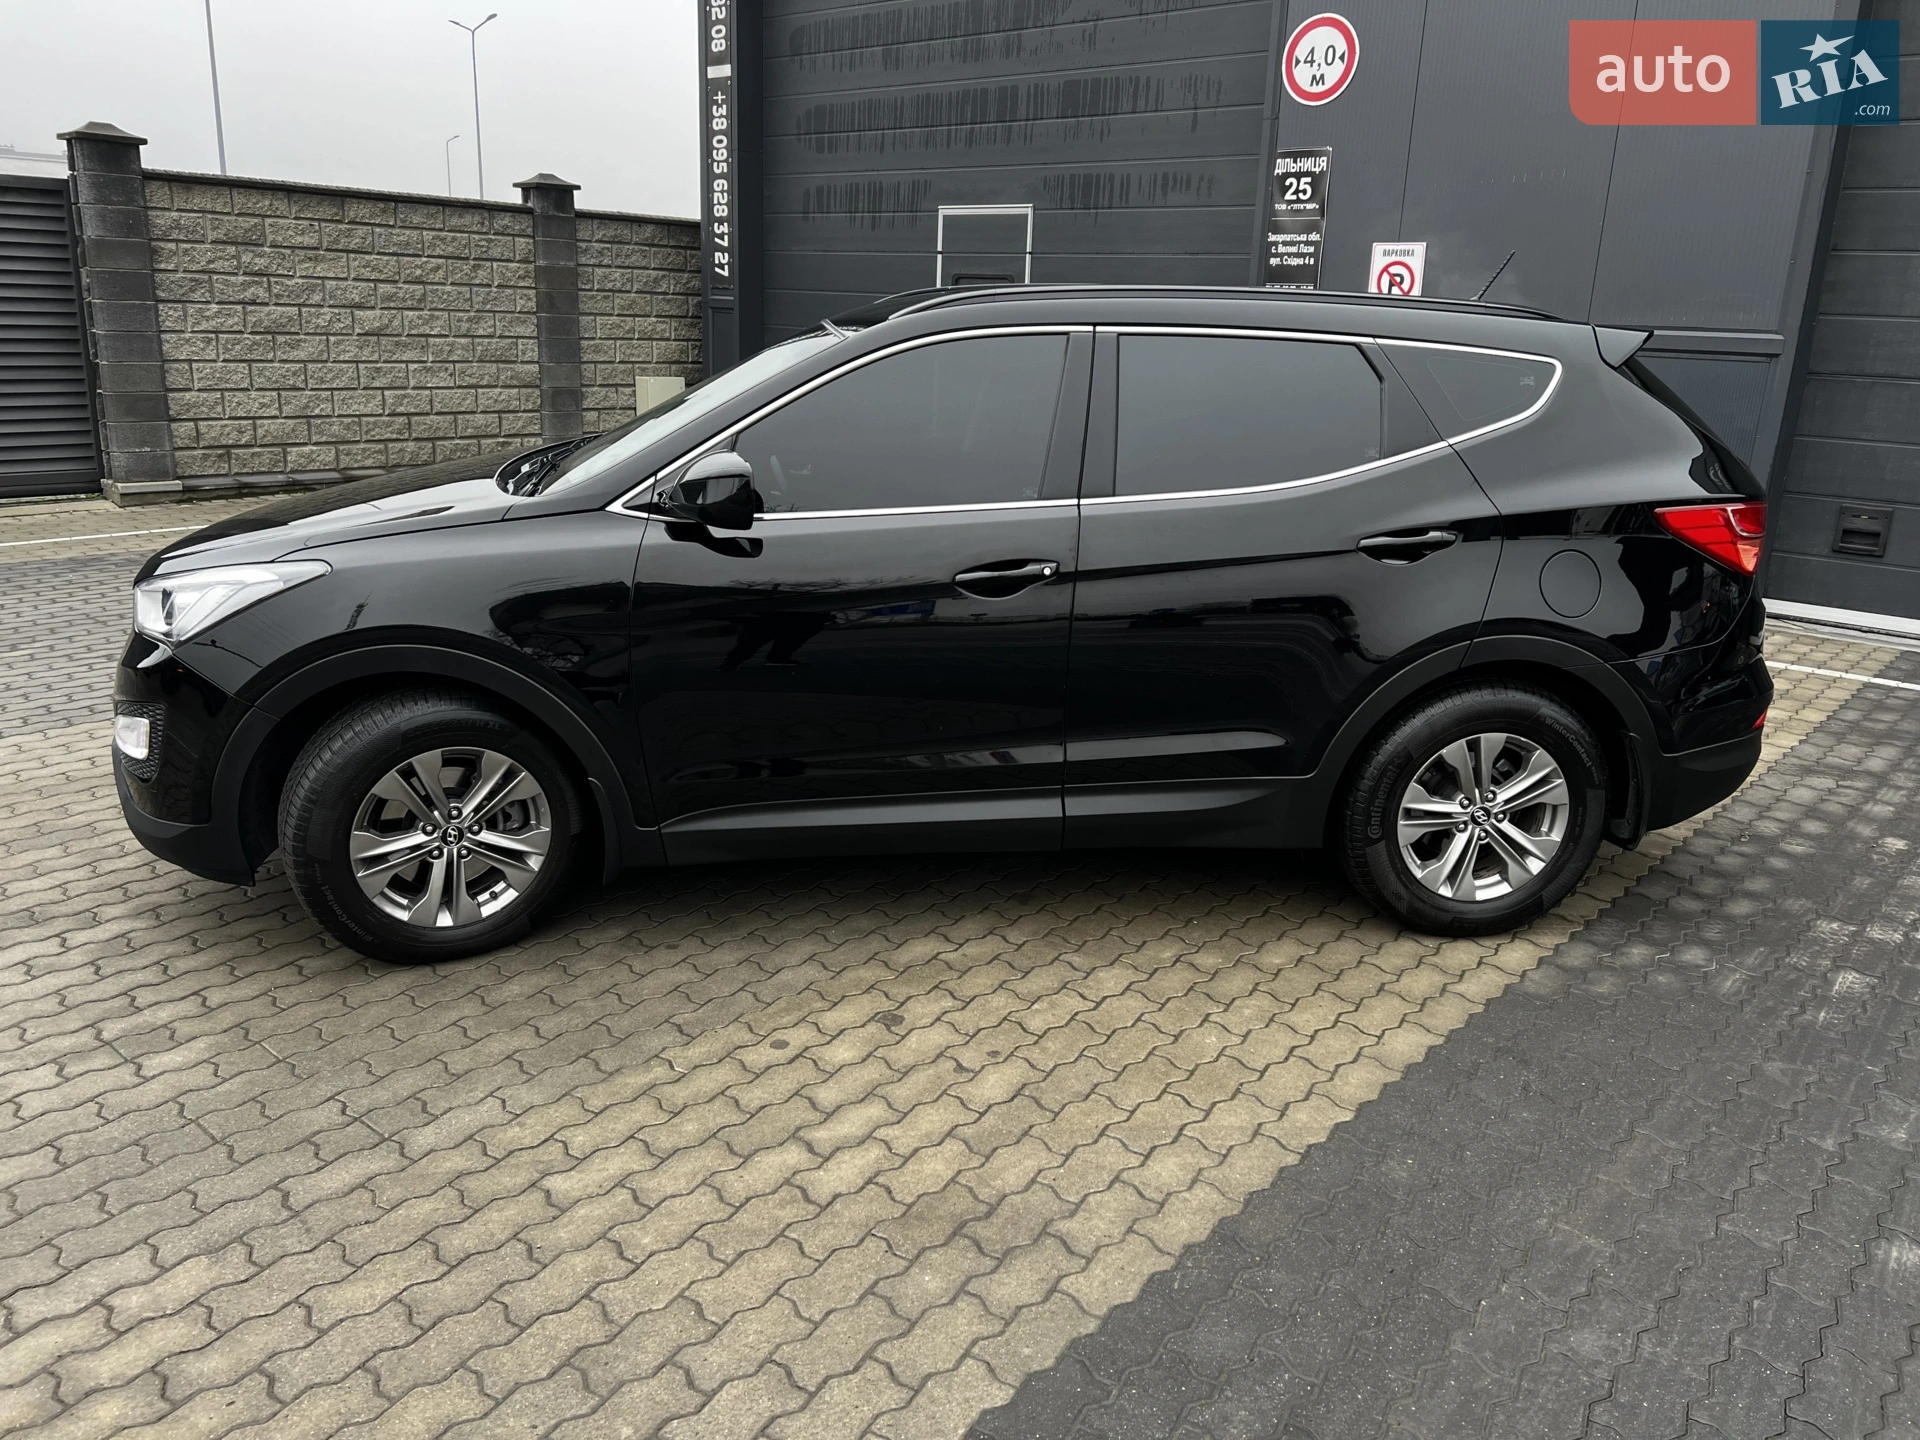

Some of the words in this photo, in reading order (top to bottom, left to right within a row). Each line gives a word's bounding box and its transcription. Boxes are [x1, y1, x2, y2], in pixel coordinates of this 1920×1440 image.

[711, 25, 727, 52] 08
[1303, 44, 1337, 71] 4,0
[712, 91, 728, 130] +38
[712, 135, 728, 174] 095
[1274, 156, 1328, 176] ДІЛЬНИЦЯ
[713, 179, 729, 217] 628
[1284, 177, 1312, 200] 25
[714, 222, 729, 247] 37
[1267, 232, 1307, 243] Закарпатська
[714, 252, 729, 277] 27
[1382, 248, 1415, 257] ПАРКОВКА
